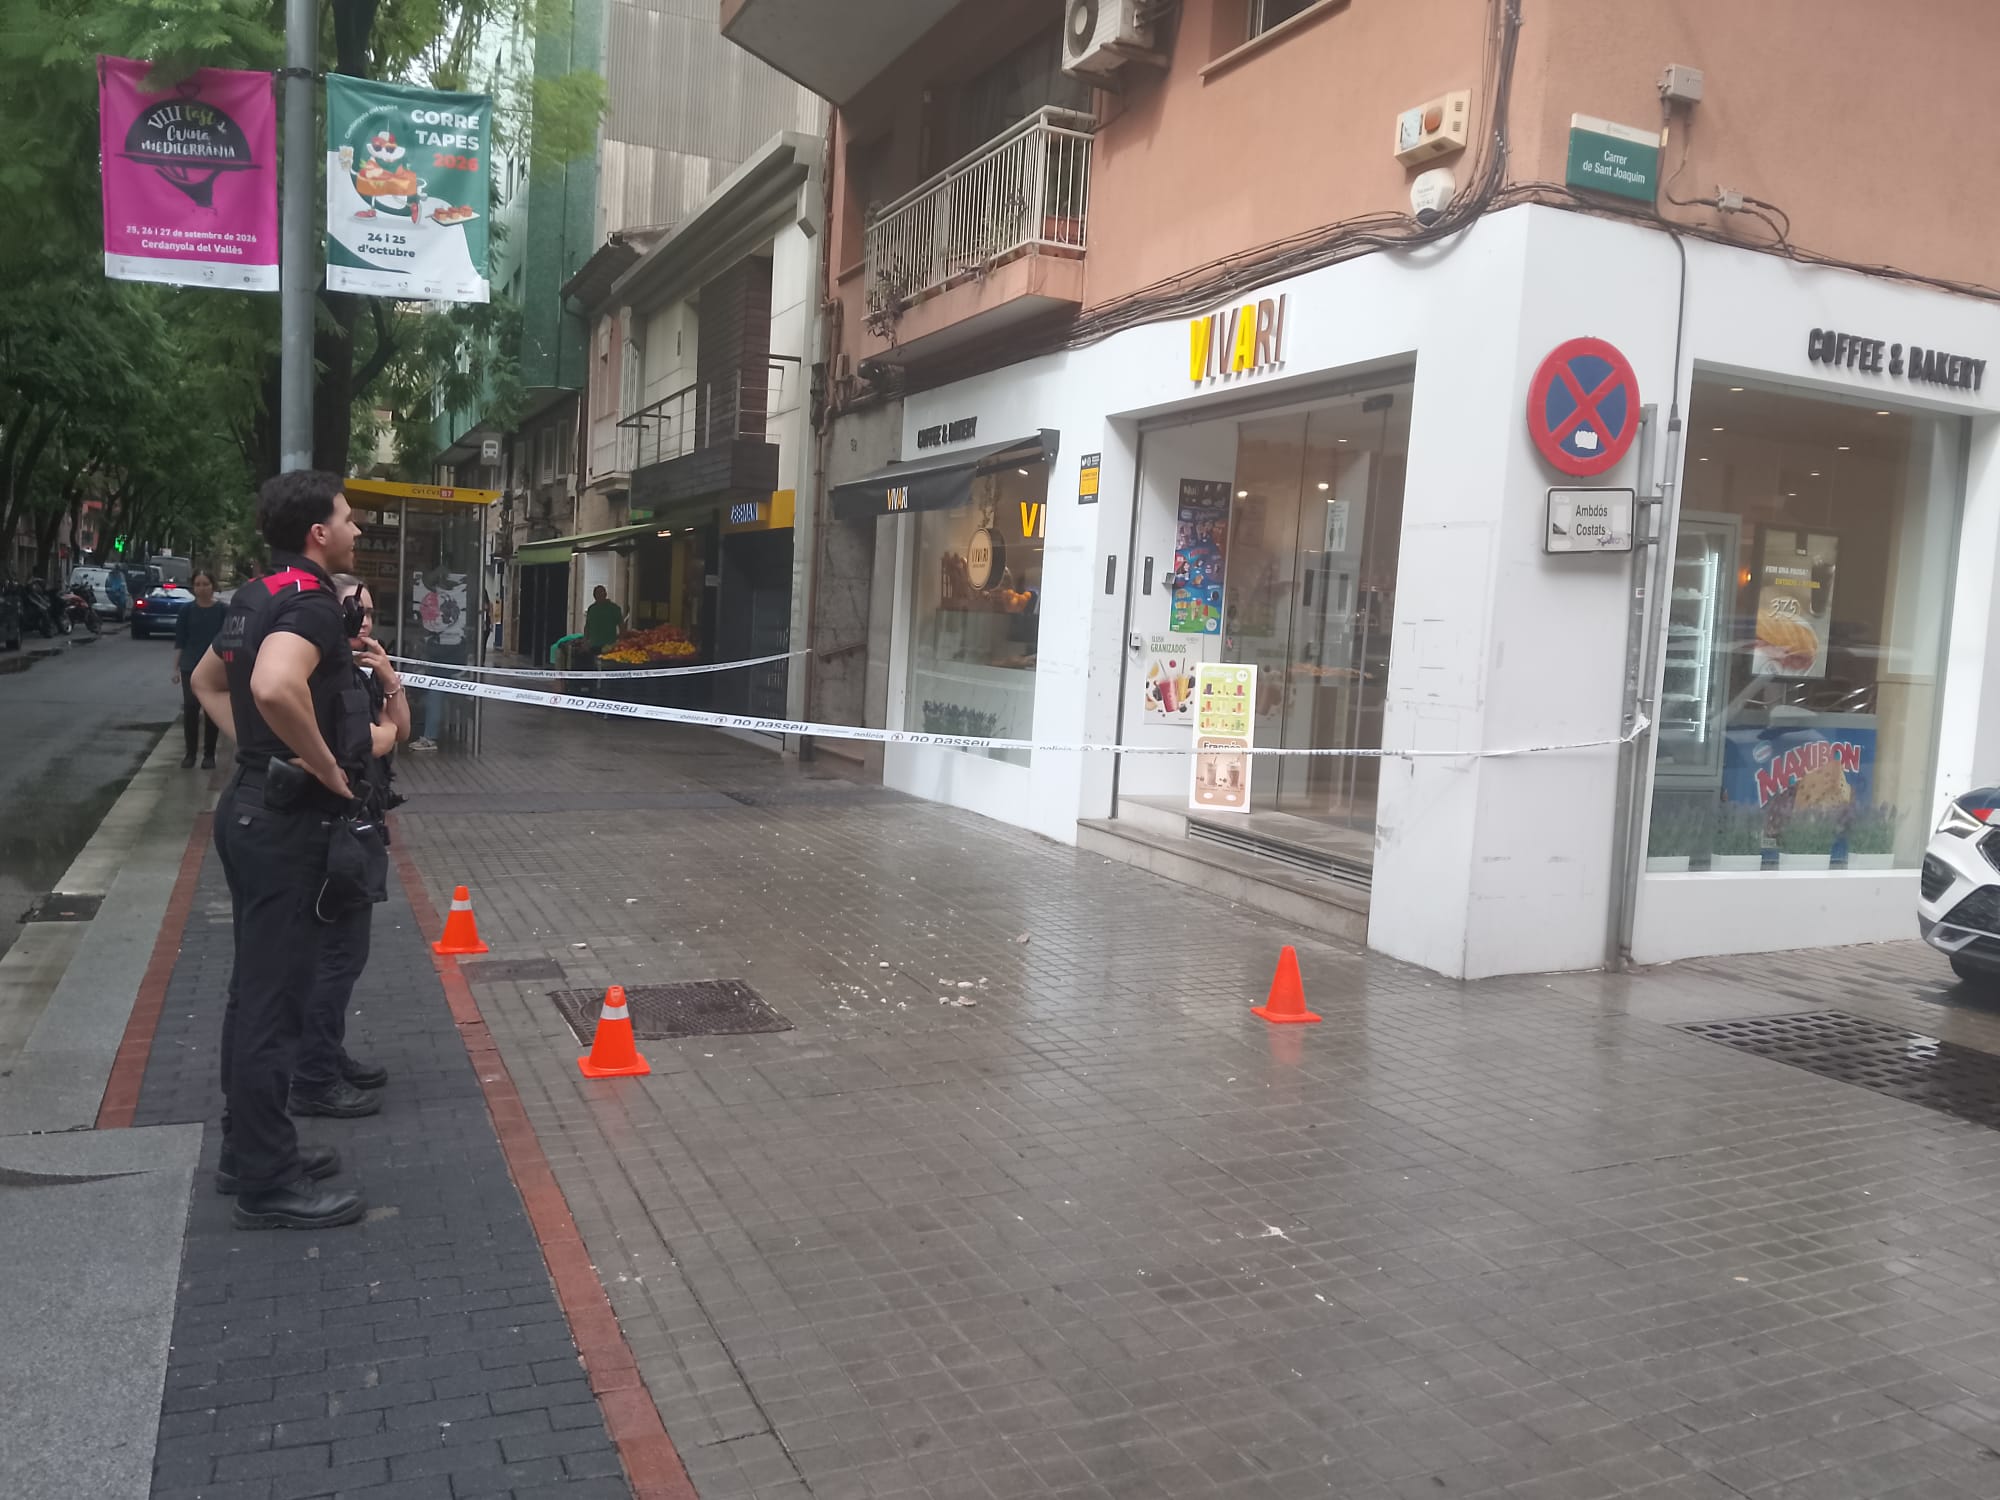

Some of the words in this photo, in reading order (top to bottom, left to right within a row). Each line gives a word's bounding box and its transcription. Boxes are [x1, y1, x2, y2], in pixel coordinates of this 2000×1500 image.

[410, 109, 480, 130] CORRE
[415, 130, 480, 151] TAPES
[433, 153, 479, 172] 2026
[1604, 150, 1628, 165] Carrer
[1582, 160, 1593, 171] de
[1594, 162, 1612, 176] Sant
[1613, 167, 1646, 184] Joaquim
[160, 227, 170, 236] 27
[172, 229, 182, 237] de
[184, 230, 222, 240] setembre
[224, 232, 234, 241] de
[236, 233, 257, 243] 2026
[367, 233, 382, 243] 24
[385, 233, 390, 243] i
[392, 235, 406, 244] 25
[141, 239, 195, 252] Cerdanyola
[197, 243, 212, 253] del
[214, 244, 243, 255] Vallès
[357, 244, 416, 258] d'octubre
[1190, 293, 1287, 382] VIVARI
[1807, 327, 1886, 373] COFFEE
[1889, 343, 1904, 375] &
[1908, 346, 1987, 391] BAKERY
[1575, 504, 1608, 517] Ambdós
[1020, 502, 1046, 538] VI
[1576, 523, 1606, 536] Costats
[409, 674, 426, 684] no
[428, 678, 478, 691] passeu
[566, 697, 584, 706] no
[586, 700, 639, 714] passeu
[732, 719, 751, 727] no
[753, 720, 809, 732] passeu
[910, 735, 929, 743] no
[1754, 741, 1861, 808] MAXIBON
